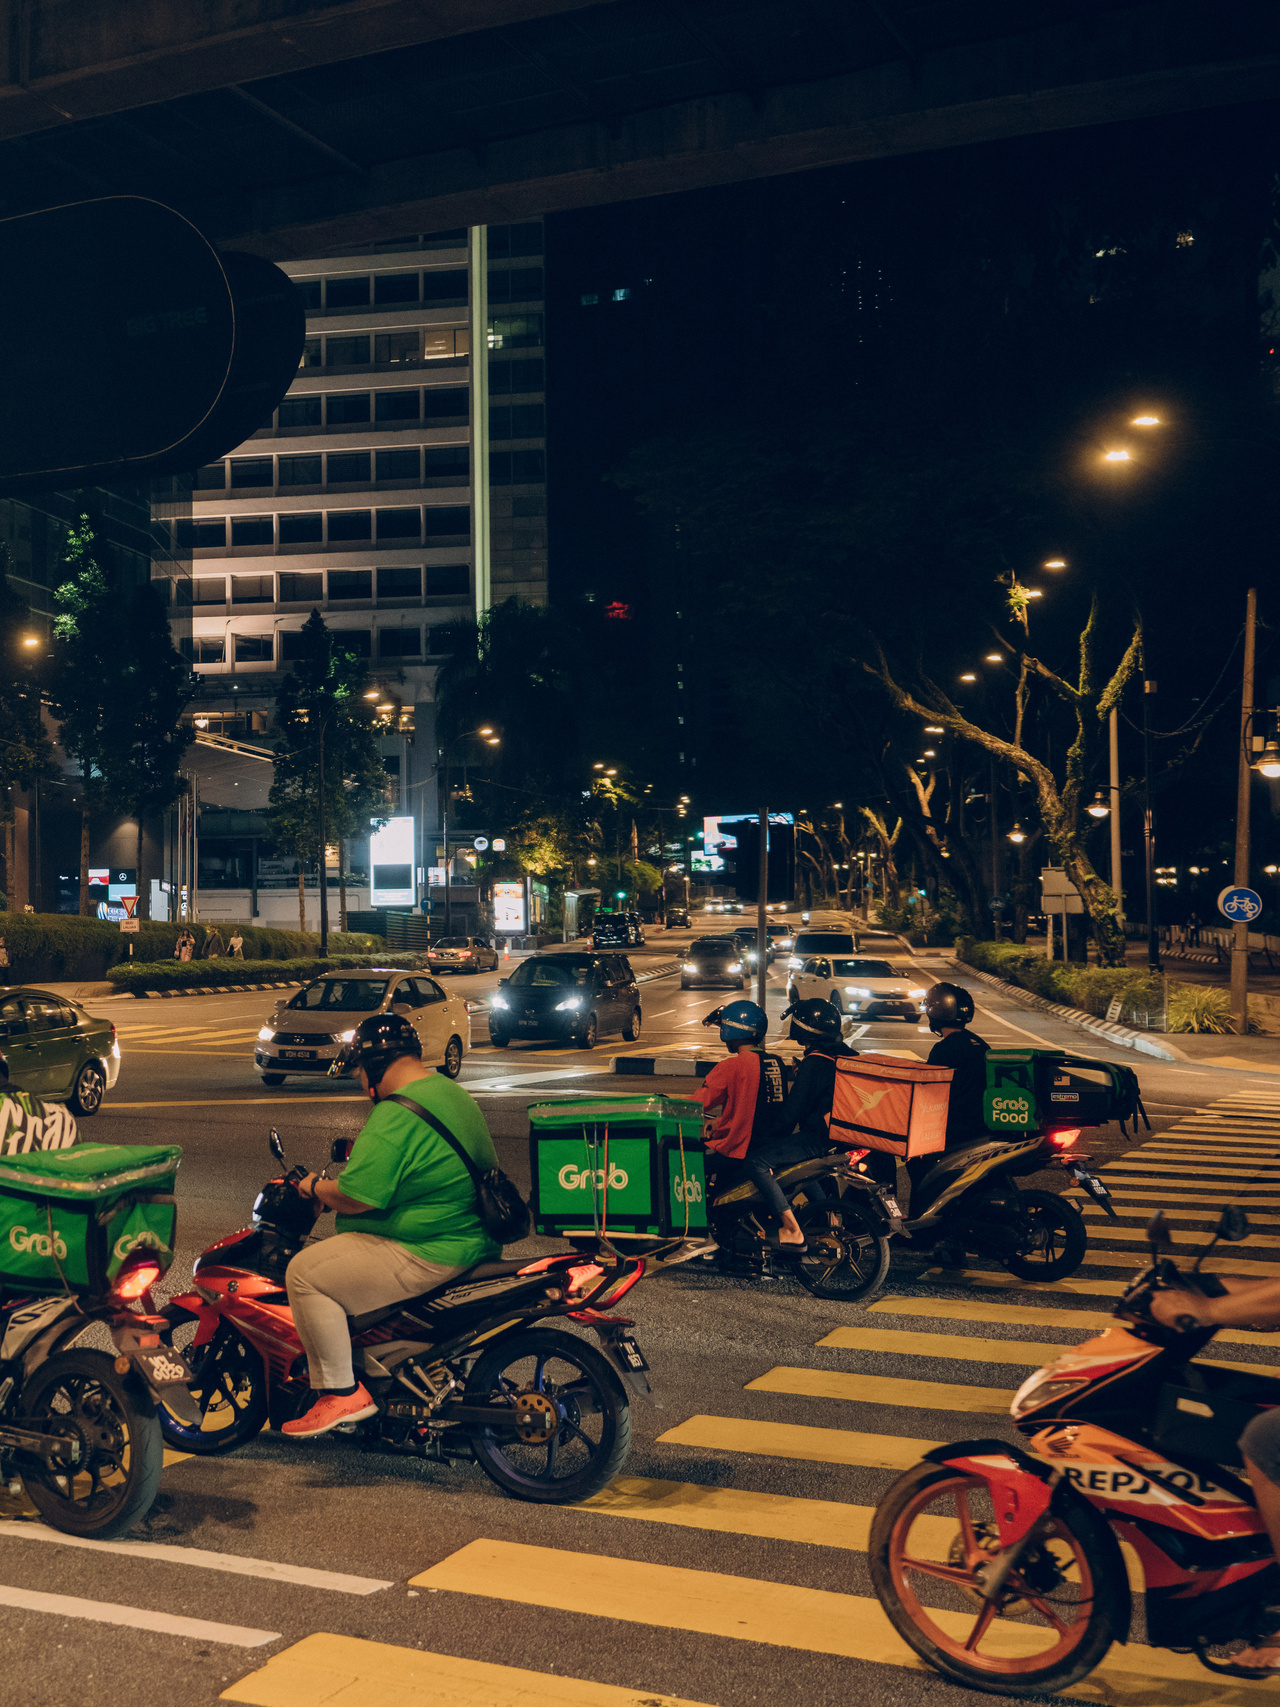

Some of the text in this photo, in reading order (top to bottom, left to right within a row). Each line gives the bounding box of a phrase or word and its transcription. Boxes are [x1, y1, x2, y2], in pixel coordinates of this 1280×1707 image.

[992, 1097, 1029, 1111] Grab
[992, 1110, 1029, 1124] Food
[558, 1162, 629, 1190] Grab
[673, 1174, 703, 1203] Grab
[9, 1225, 68, 1260] Grab
[153, 1364, 185, 1381] 6029
